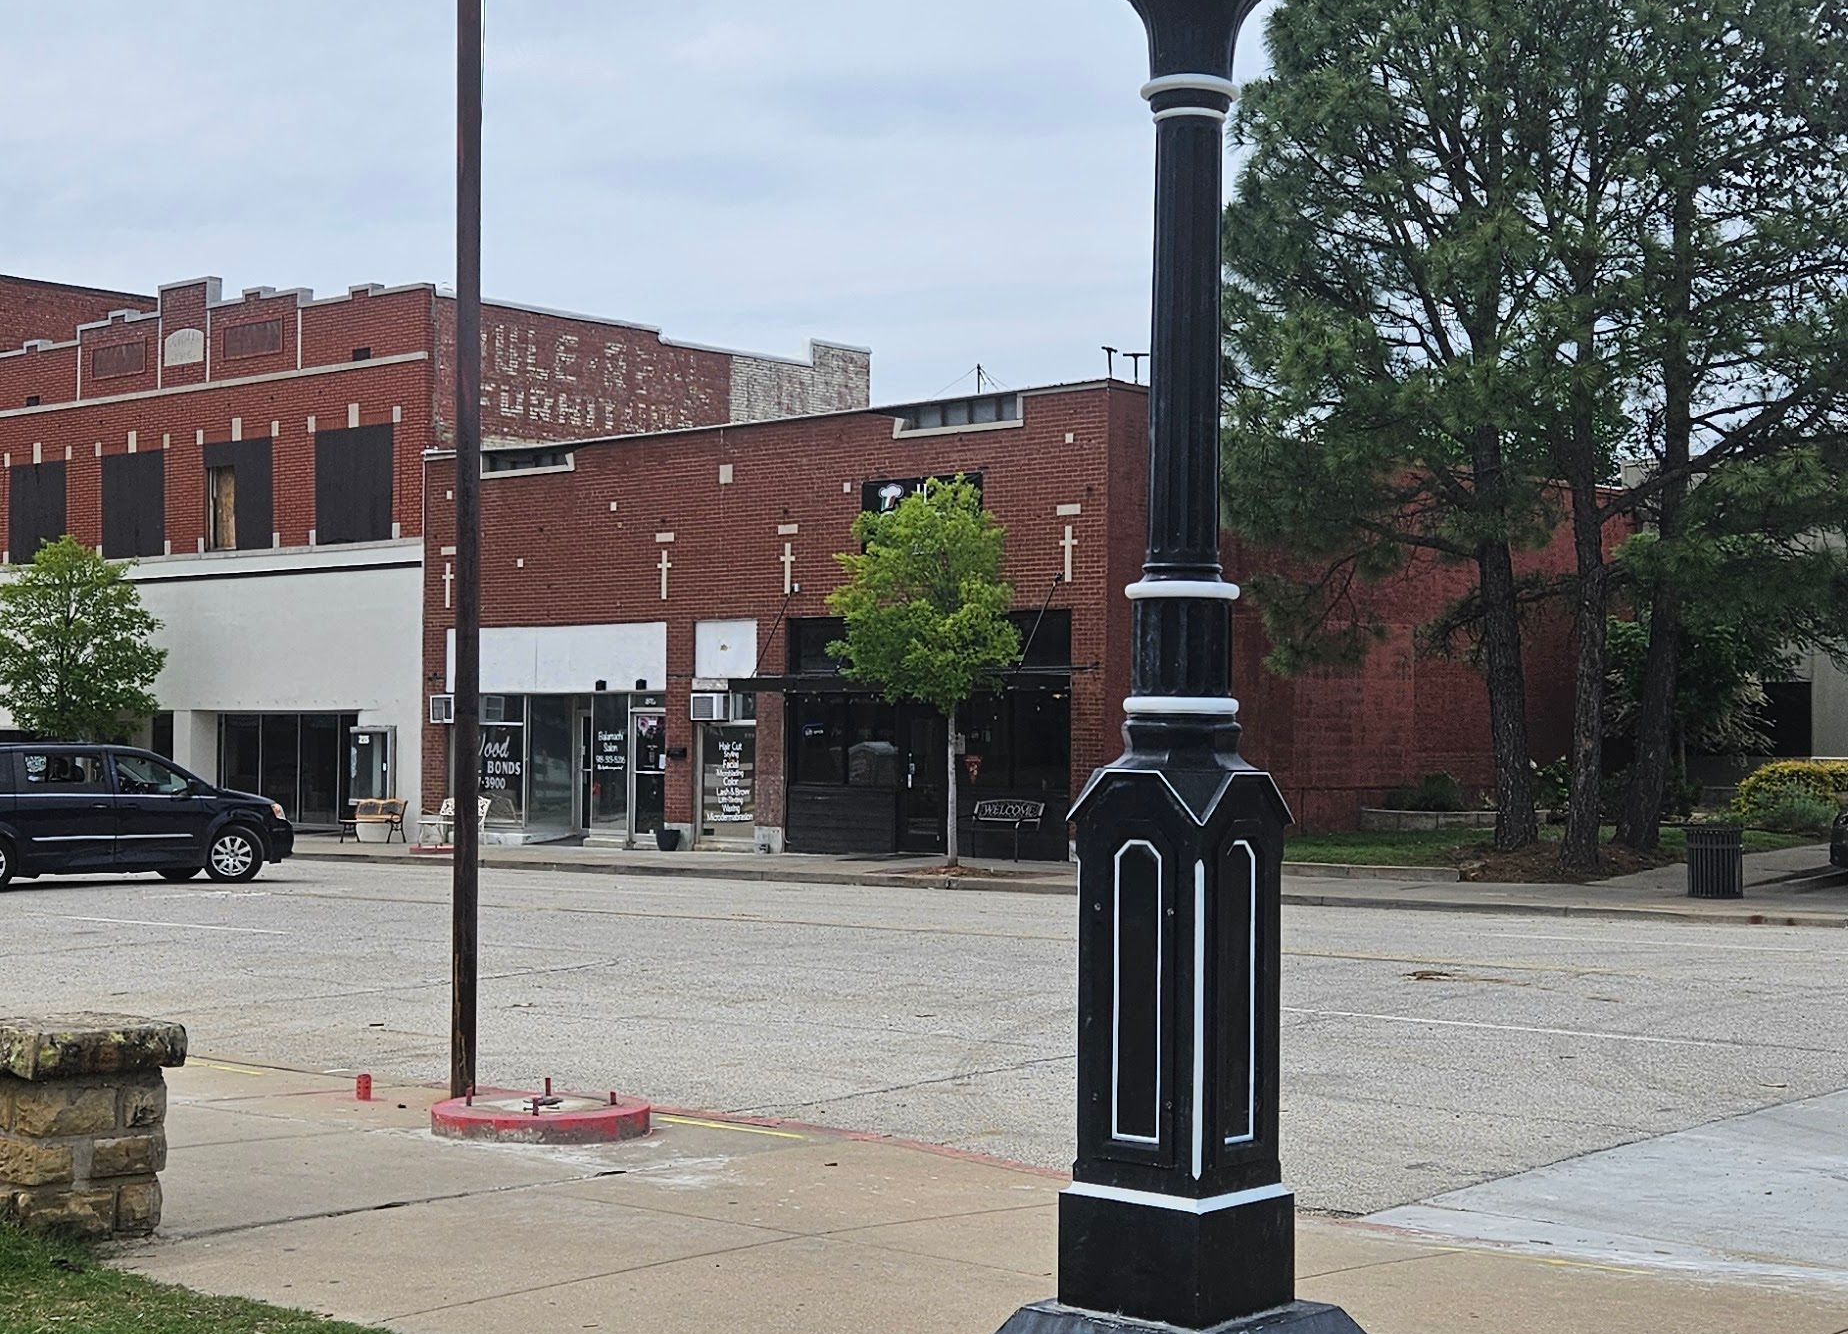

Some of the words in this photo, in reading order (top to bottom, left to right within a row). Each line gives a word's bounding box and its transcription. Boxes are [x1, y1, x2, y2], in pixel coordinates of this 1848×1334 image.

[718, 741, 731, 751] Hair
[731, 741, 743, 751] Cut
[487, 761, 521, 775] BONDS
[722, 759, 740, 769] Facial
[722, 777, 740, 786] Color
[716, 787, 730, 796] Lash
[735, 787, 751, 796] Brow
[981, 803, 1039, 817] WELCOME
